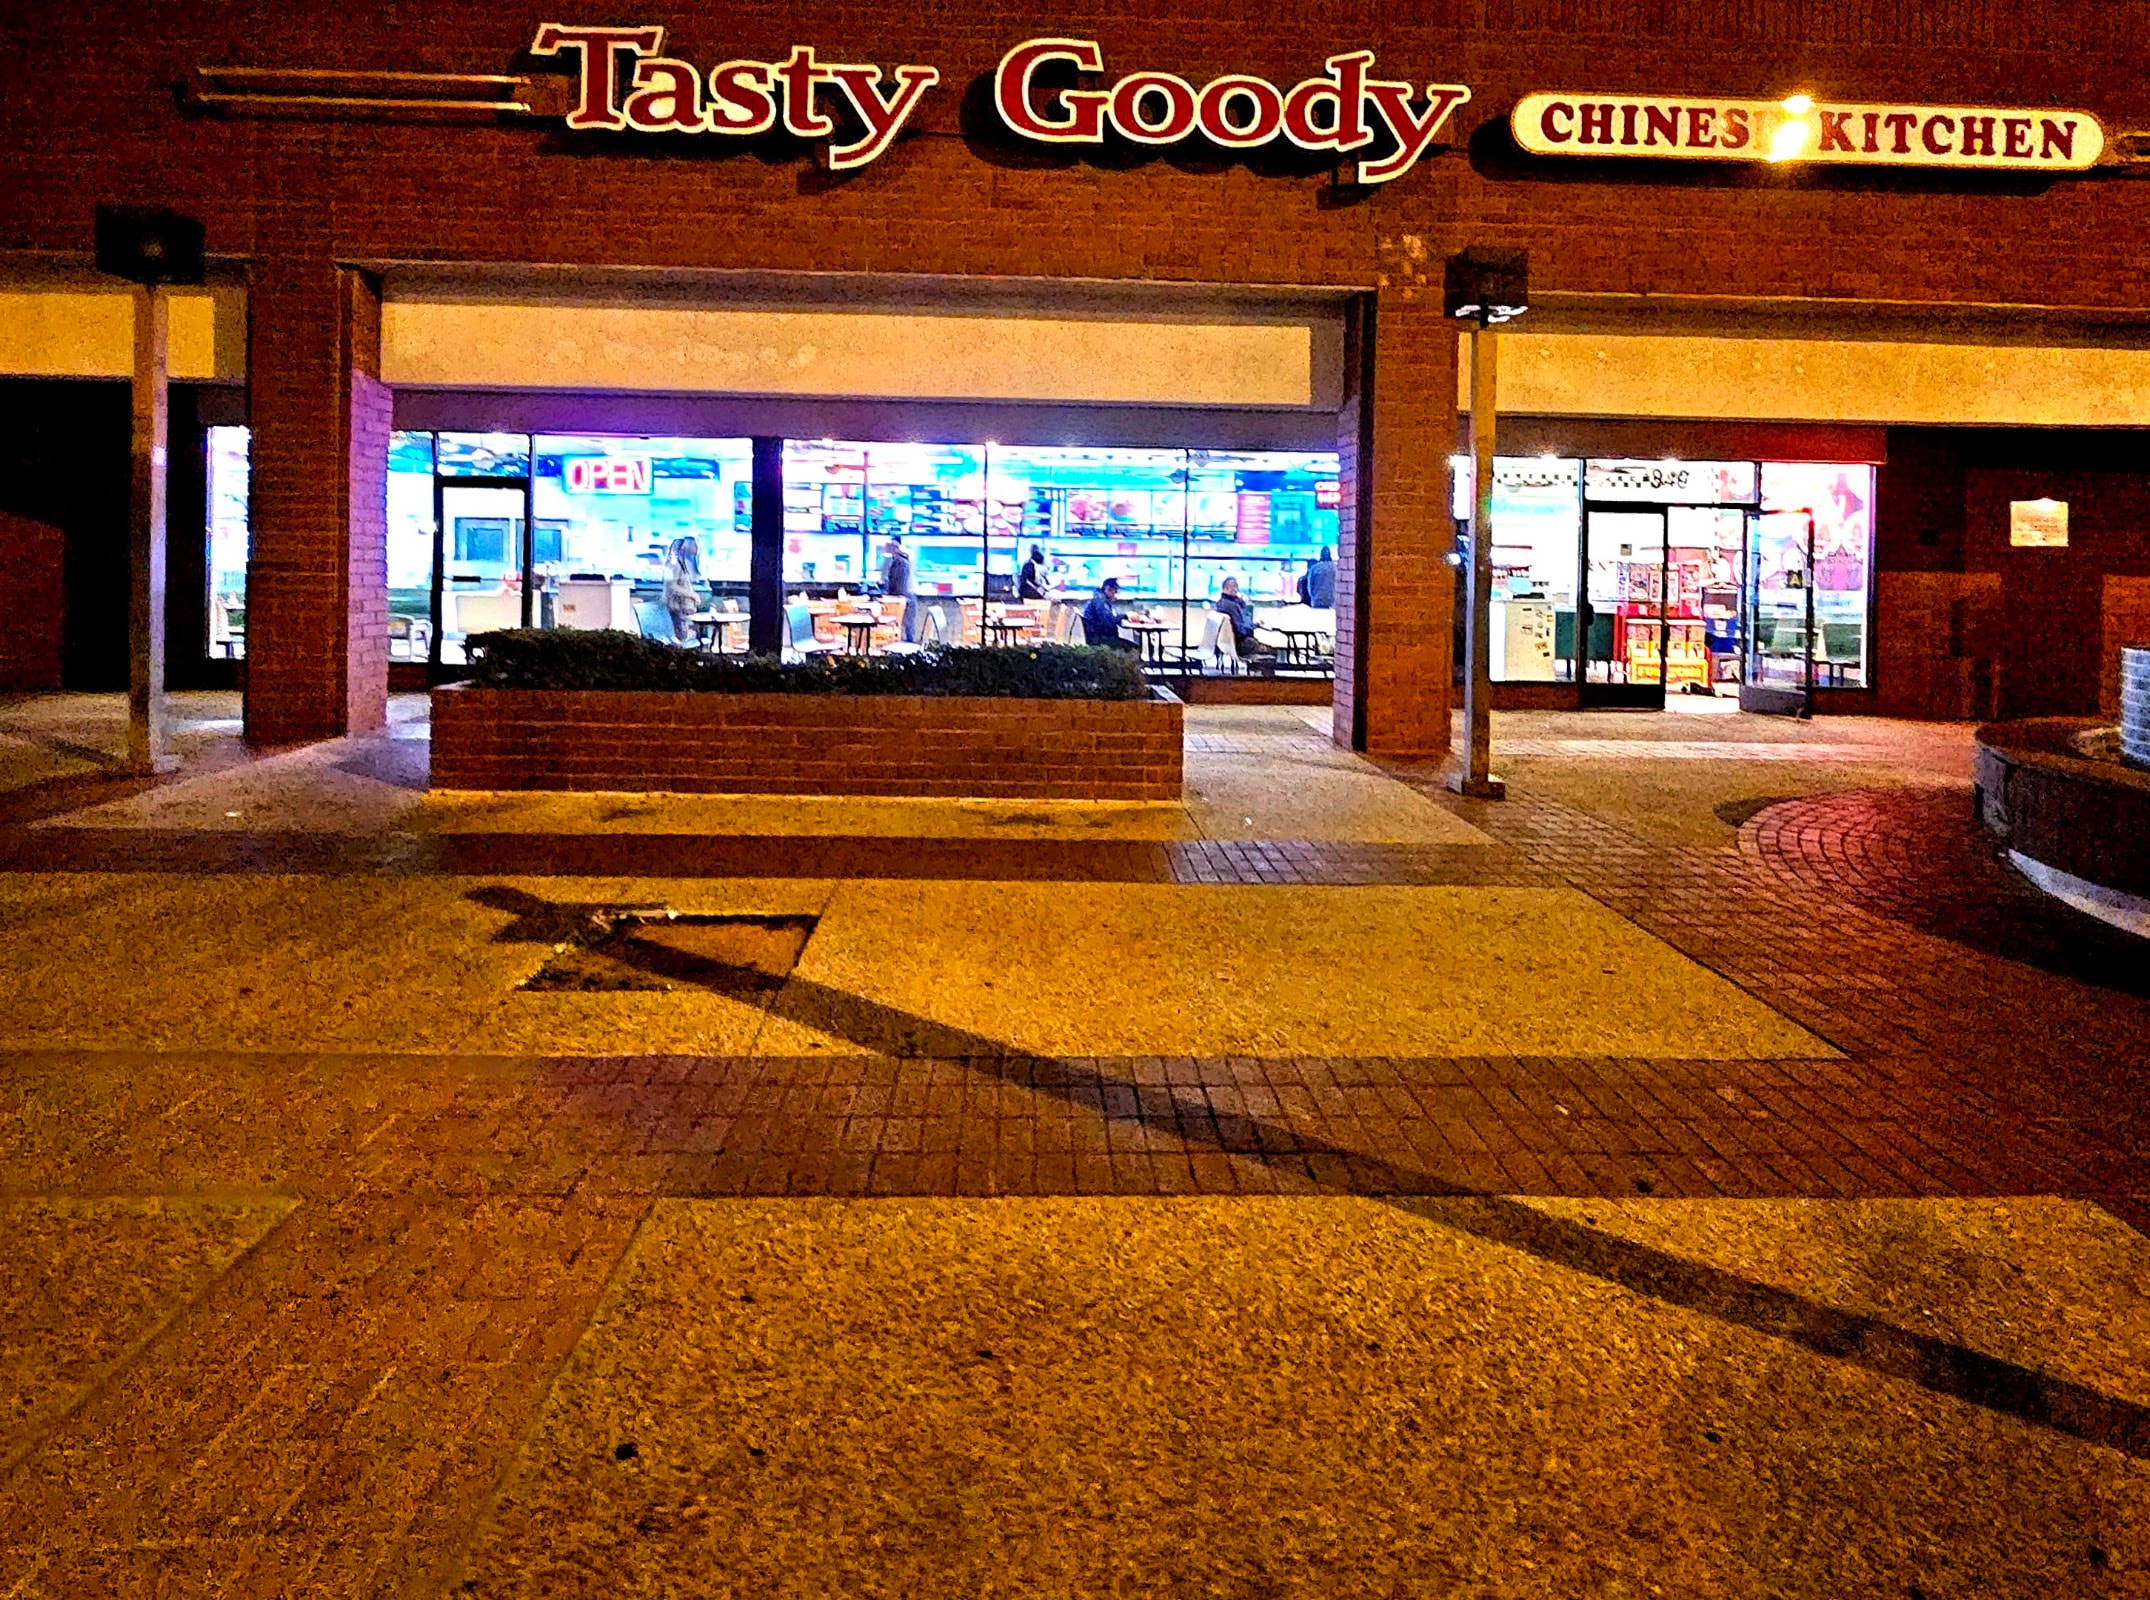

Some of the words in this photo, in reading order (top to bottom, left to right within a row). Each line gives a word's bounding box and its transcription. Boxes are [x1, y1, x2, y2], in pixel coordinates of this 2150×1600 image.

[530, 23, 939, 169] Tasty
[995, 38, 1471, 183] Goody
[1818, 110, 2077, 160] KITCHEN
[567, 458, 650, 492] OPEN
